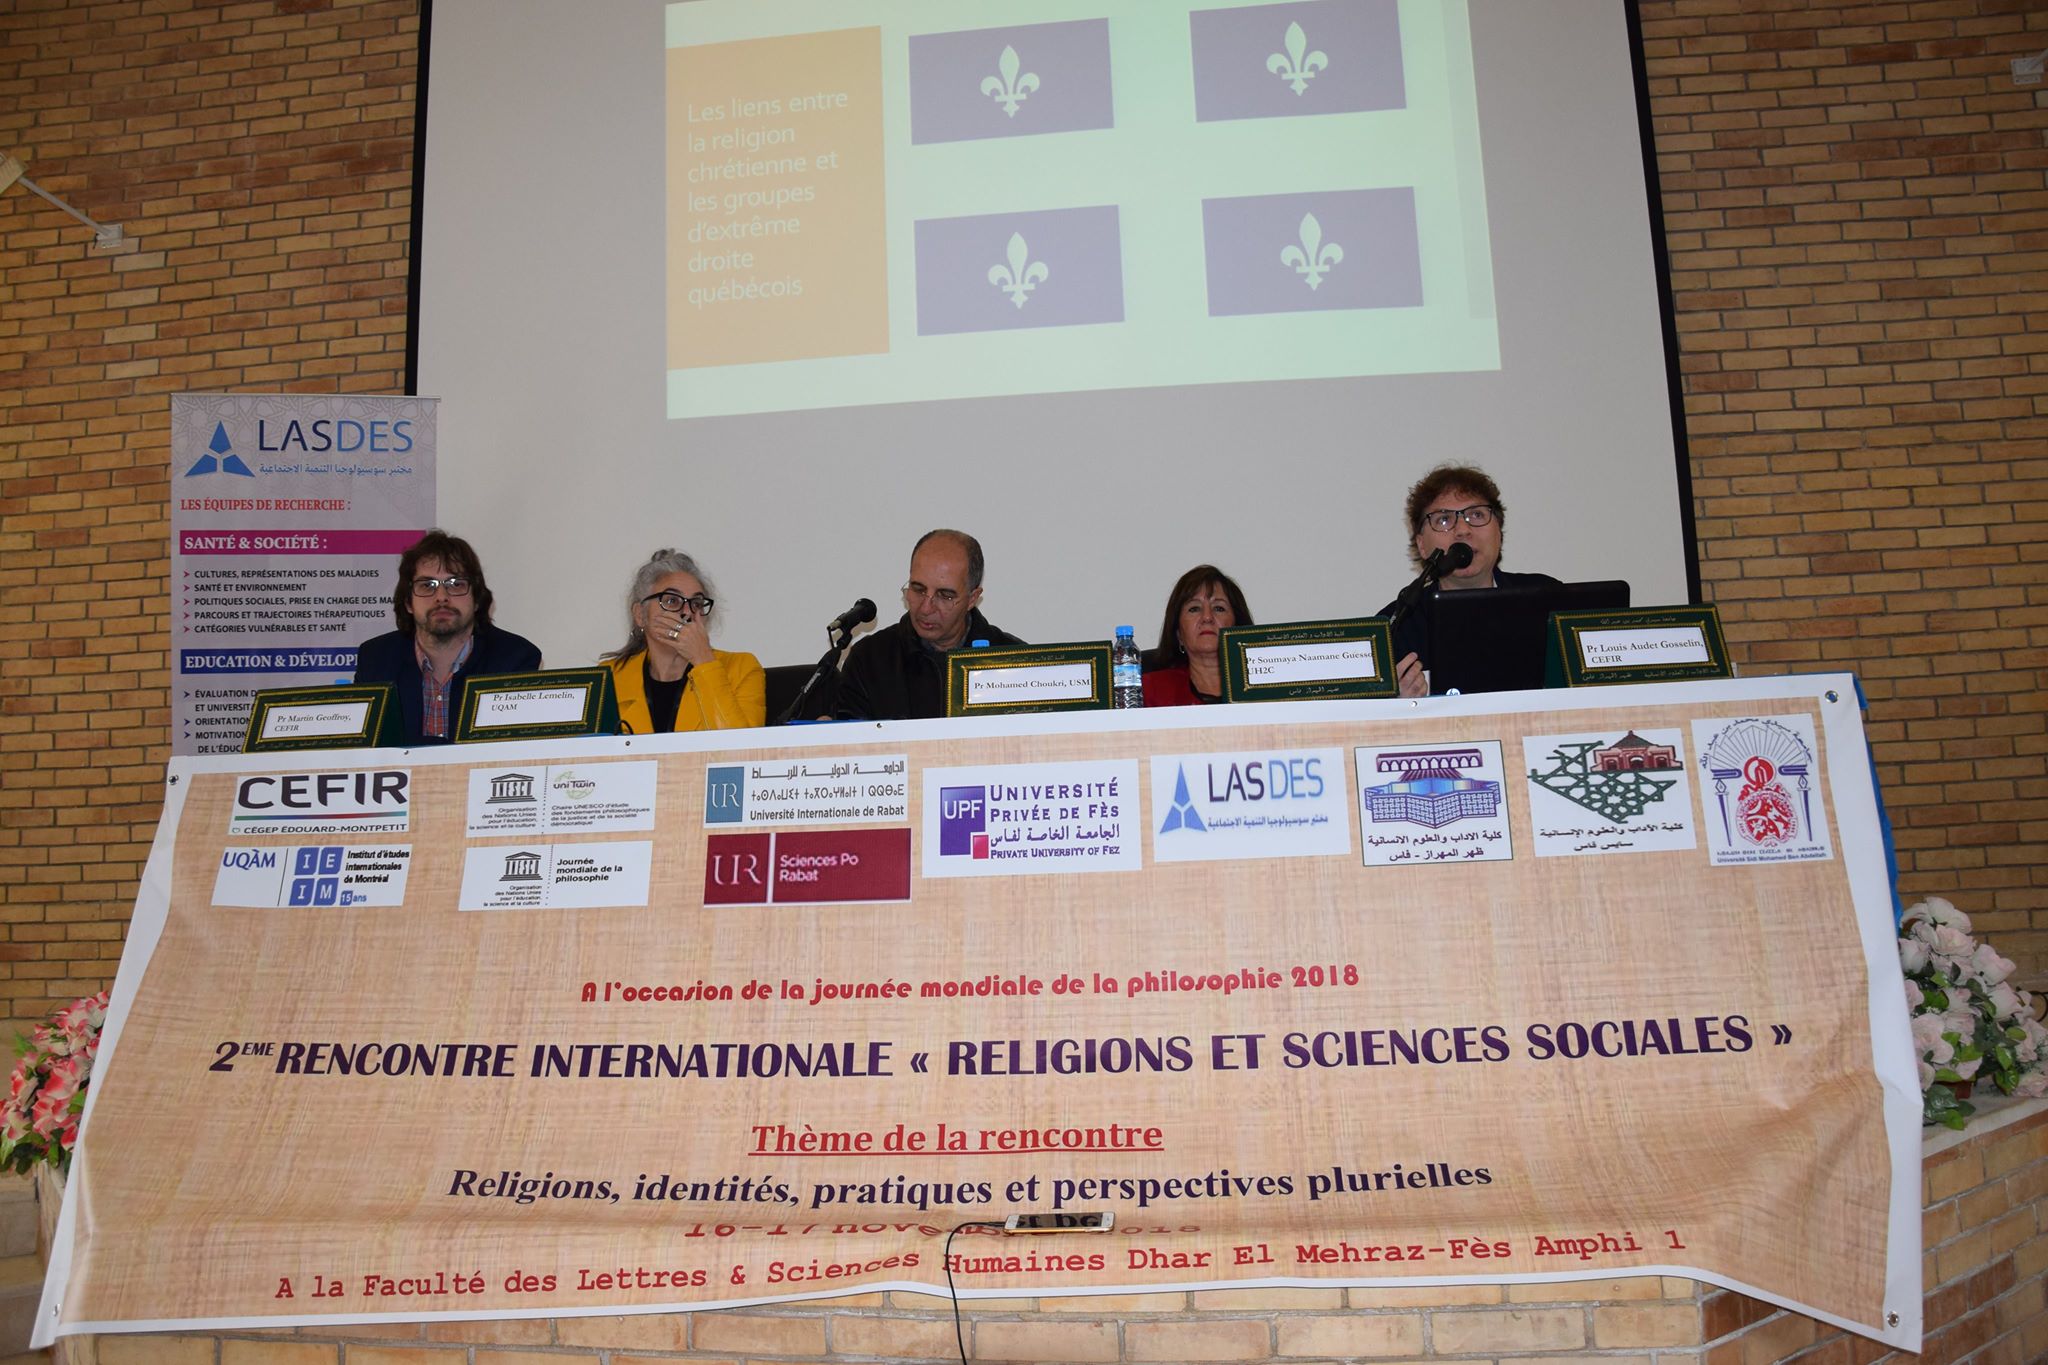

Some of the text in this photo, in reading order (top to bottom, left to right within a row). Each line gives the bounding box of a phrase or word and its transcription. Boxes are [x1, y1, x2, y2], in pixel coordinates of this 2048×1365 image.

[688, 92, 848, 122] Les liens entre
[688, 126, 795, 152] la religion
[688, 152, 839, 183] chrétienne et
[688, 186, 815, 214] les groupes
[688, 252, 754, 273] droite
[688, 276, 802, 310] québécois
[259, 420, 413, 452] LASDES
[180, 497, 344, 512] LES ÉQUIPES DE RECHERCHE
[184, 535, 320, 549] SANTÉ & SOCIÉTÉ
[194, 568, 379, 579] CULTURES, REPRÉSENTATIONS DES MALADIES
[194, 583, 306, 592] SANTÉ ET ENVIRONNEMENT
[194, 598, 243, 606] POLITIQUES
[245, 597, 287, 606] SOCIALES,
[289, 596, 311, 605] PRISE
[314, 596, 324, 605] EN
[326, 596, 360, 605] CHARGE
[362, 596, 378, 605] DES
[194, 608, 385, 620] PARCOURS ET TRAJECTOIRES THÉRAPEUTIQUES
[194, 622, 346, 633] CATÉGORIES VULNÉRABLES ET SANTÉ
[1587, 640, 1704, 654] Pr Louis Audet Gosselin,
[186, 655, 286, 668] EDUCATION &
[1258, 655, 1296, 664] Soumaya
[1299, 653, 1340, 662] Naamane
[1592, 656, 1622, 664] CEFIR
[974, 678, 1090, 690] Pr Mohamed Choukri, USM
[195, 690, 248, 698] ÉVALUATION
[504, 692, 536, 700] Isabelle
[538, 692, 574, 700] Lemelin,
[492, 704, 517, 712] UQAM
[238, 772, 408, 809] CEFIR
[991, 777, 1118, 801] UNIVERSITÉ
[750, 805, 904, 820] Université Internationale de Rabat
[944, 800, 982, 819] UPF
[991, 802, 1118, 822] PRIVÉE DE FÈS
[244, 823, 407, 834] CÉGEP ÉDOUARD-MONTPETIT
[991, 824, 1120, 847] الجامعة الخاصة لفاس
[1413, 834, 1447, 846] والعلوم
[1483, 831, 1502, 842] كلية
[223, 849, 276, 870] UQÀM
[348, 850, 410, 859] Institut d'études
[780, 853, 858, 868] Sciences Po
[1390, 847, 1484, 861] ظهر المهراز فاس
[345, 862, 402, 872] internationales
[557, 858, 594, 866] Journée
[556, 866, 598, 874] mondiale
[614, 865, 622, 873] la
[780, 869, 818, 882] Rabat
[344, 874, 389, 884] de Montréal
[555, 874, 608, 884] philosophie
[581, 964, 1360, 1005] A l'occasion de la journée mondiale de la philosophie 2018
[275, 1042, 517, 1078] RENCONTRE
[530, 1042, 894, 1078] INTERNATIONALE
[948, 1035, 1192, 1076] RELIGIONS
[1211, 1034, 1265, 1070] ET
[1282, 1025, 1510, 1068] SCIENCES
[1527, 1014, 1753, 1060] SOCIALES
[752, 1122, 1162, 1152] Thème de la rencontre
[448, 1162, 1492, 1210] Religions, identités, pratiques et perspectives plurielles
[275, 1230, 1686, 1298] A la Faculté des Lettres & Sciences Humaines Dhar El Mehraz-Fès Amphi 1
